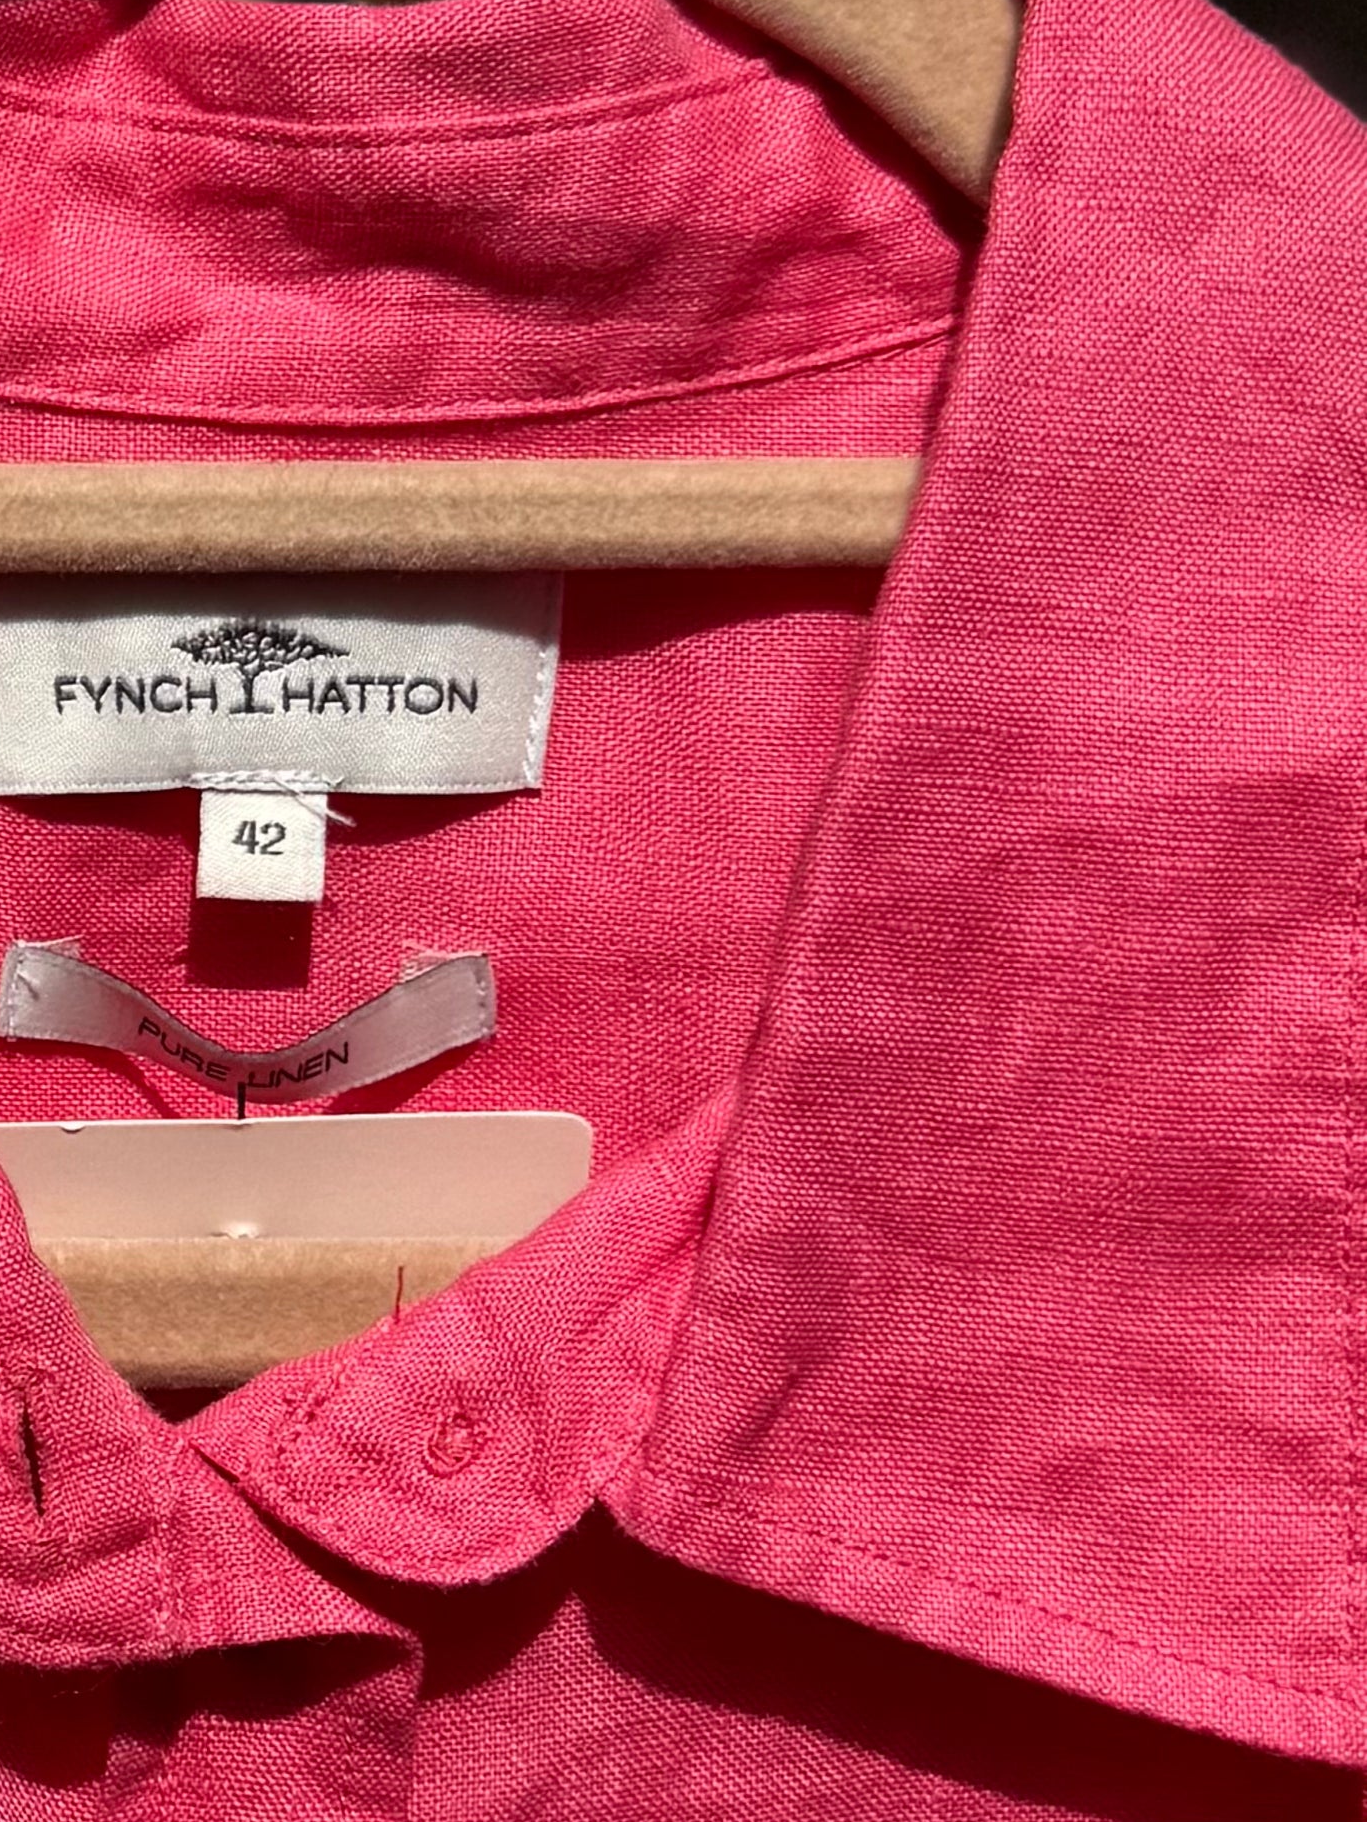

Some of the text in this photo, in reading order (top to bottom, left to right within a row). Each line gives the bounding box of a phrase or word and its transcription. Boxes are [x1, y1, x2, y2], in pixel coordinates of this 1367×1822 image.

[53, 676, 479, 716] FYNCH HATTON
[230, 819, 288, 857] 42
[137, 1015, 351, 1089] PURE LINEN
